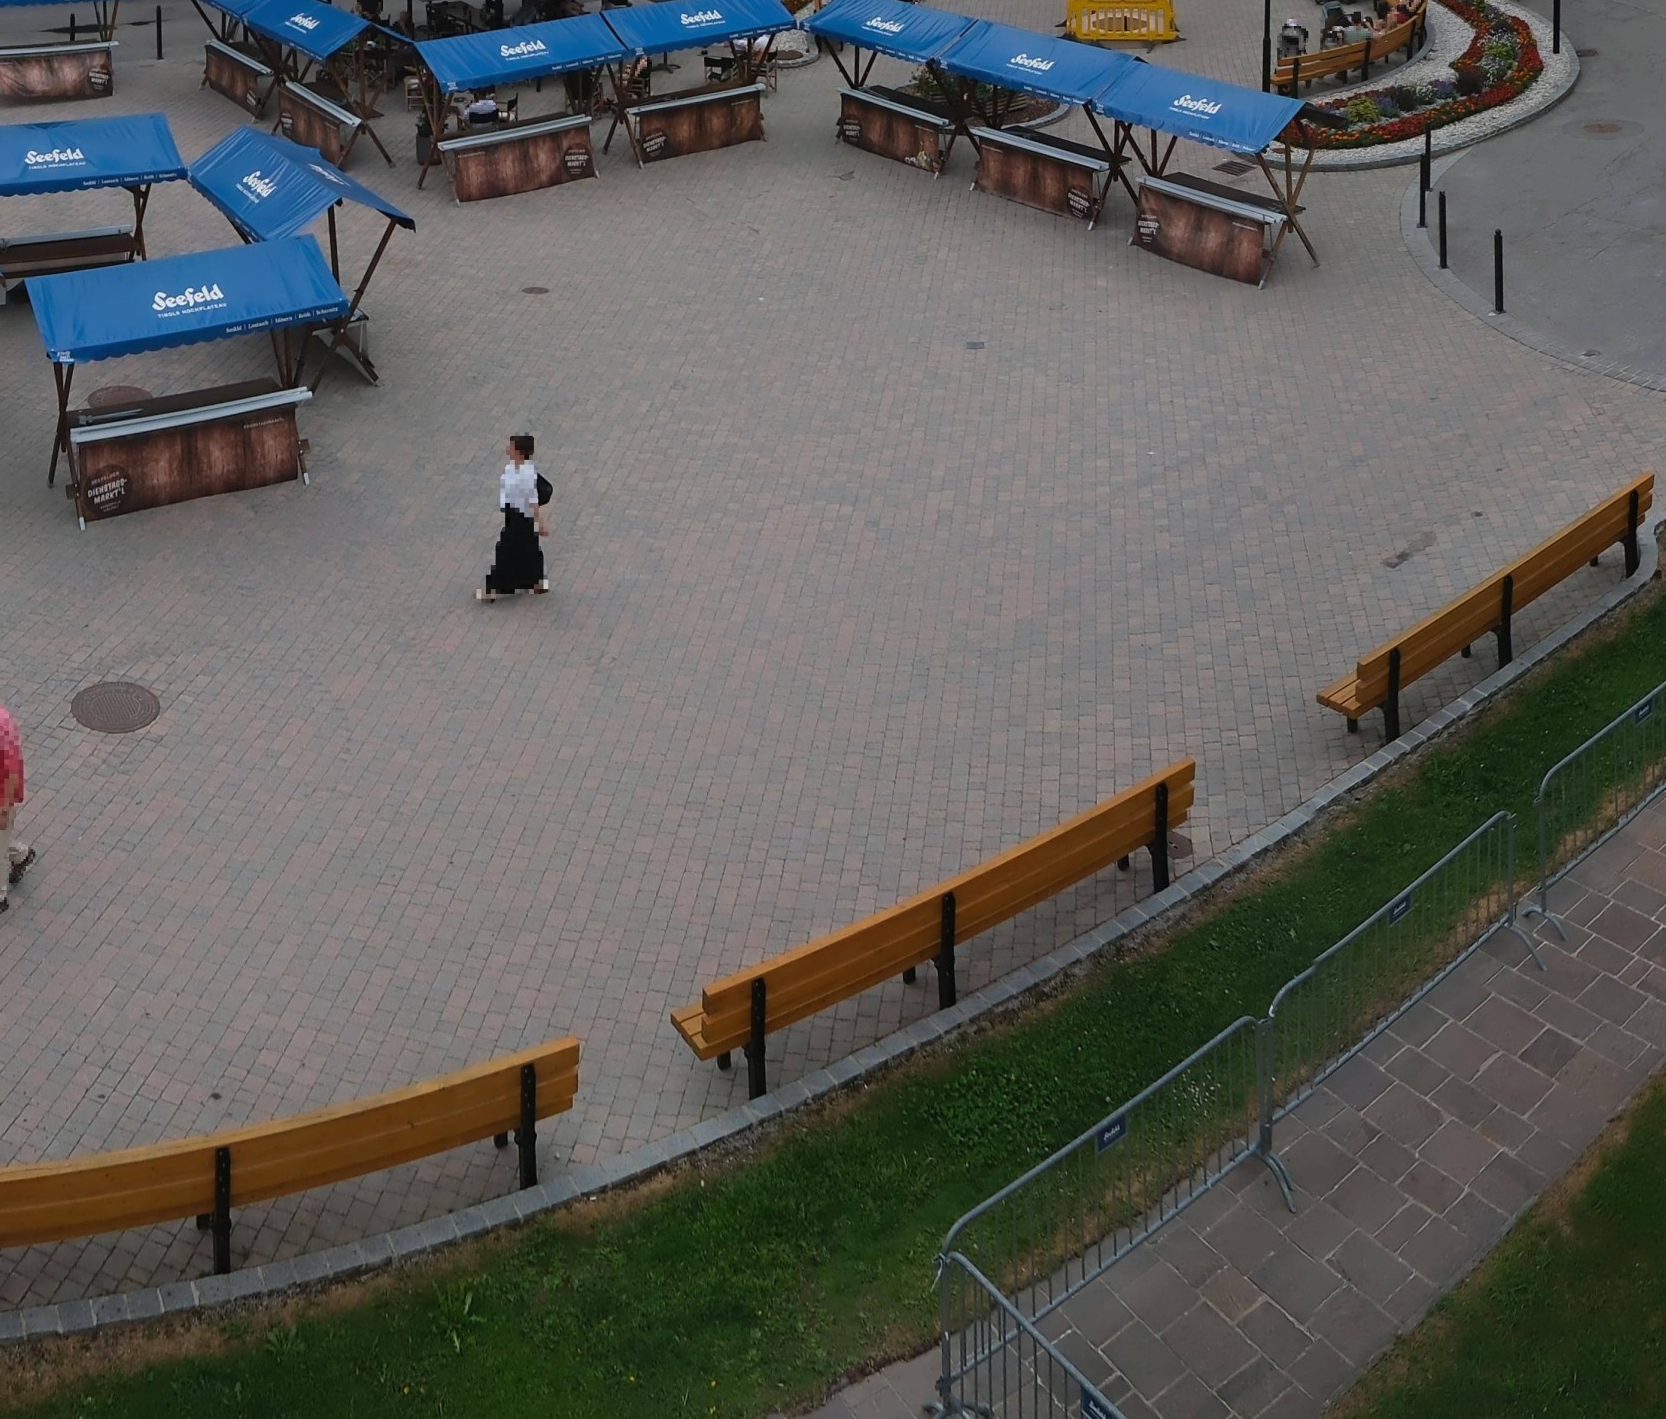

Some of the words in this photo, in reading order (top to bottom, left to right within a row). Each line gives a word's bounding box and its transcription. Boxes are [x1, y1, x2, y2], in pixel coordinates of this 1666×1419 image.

[680, 9, 722, 24] Seefeld
[866, 16, 904, 34] Seefeld
[500, 39, 547, 57] Seefeld
[1010, 53, 1055, 71] Seefeld
[1173, 94, 1222, 115] Seefeld
[24, 147, 85, 165] Seefeld
[243, 171, 277, 198] Seefeld
[152, 283, 225, 311] Seefeld
[157, 311, 181, 319] TIROLS
[181, 302, 228, 315] HOCHPLATEAU
